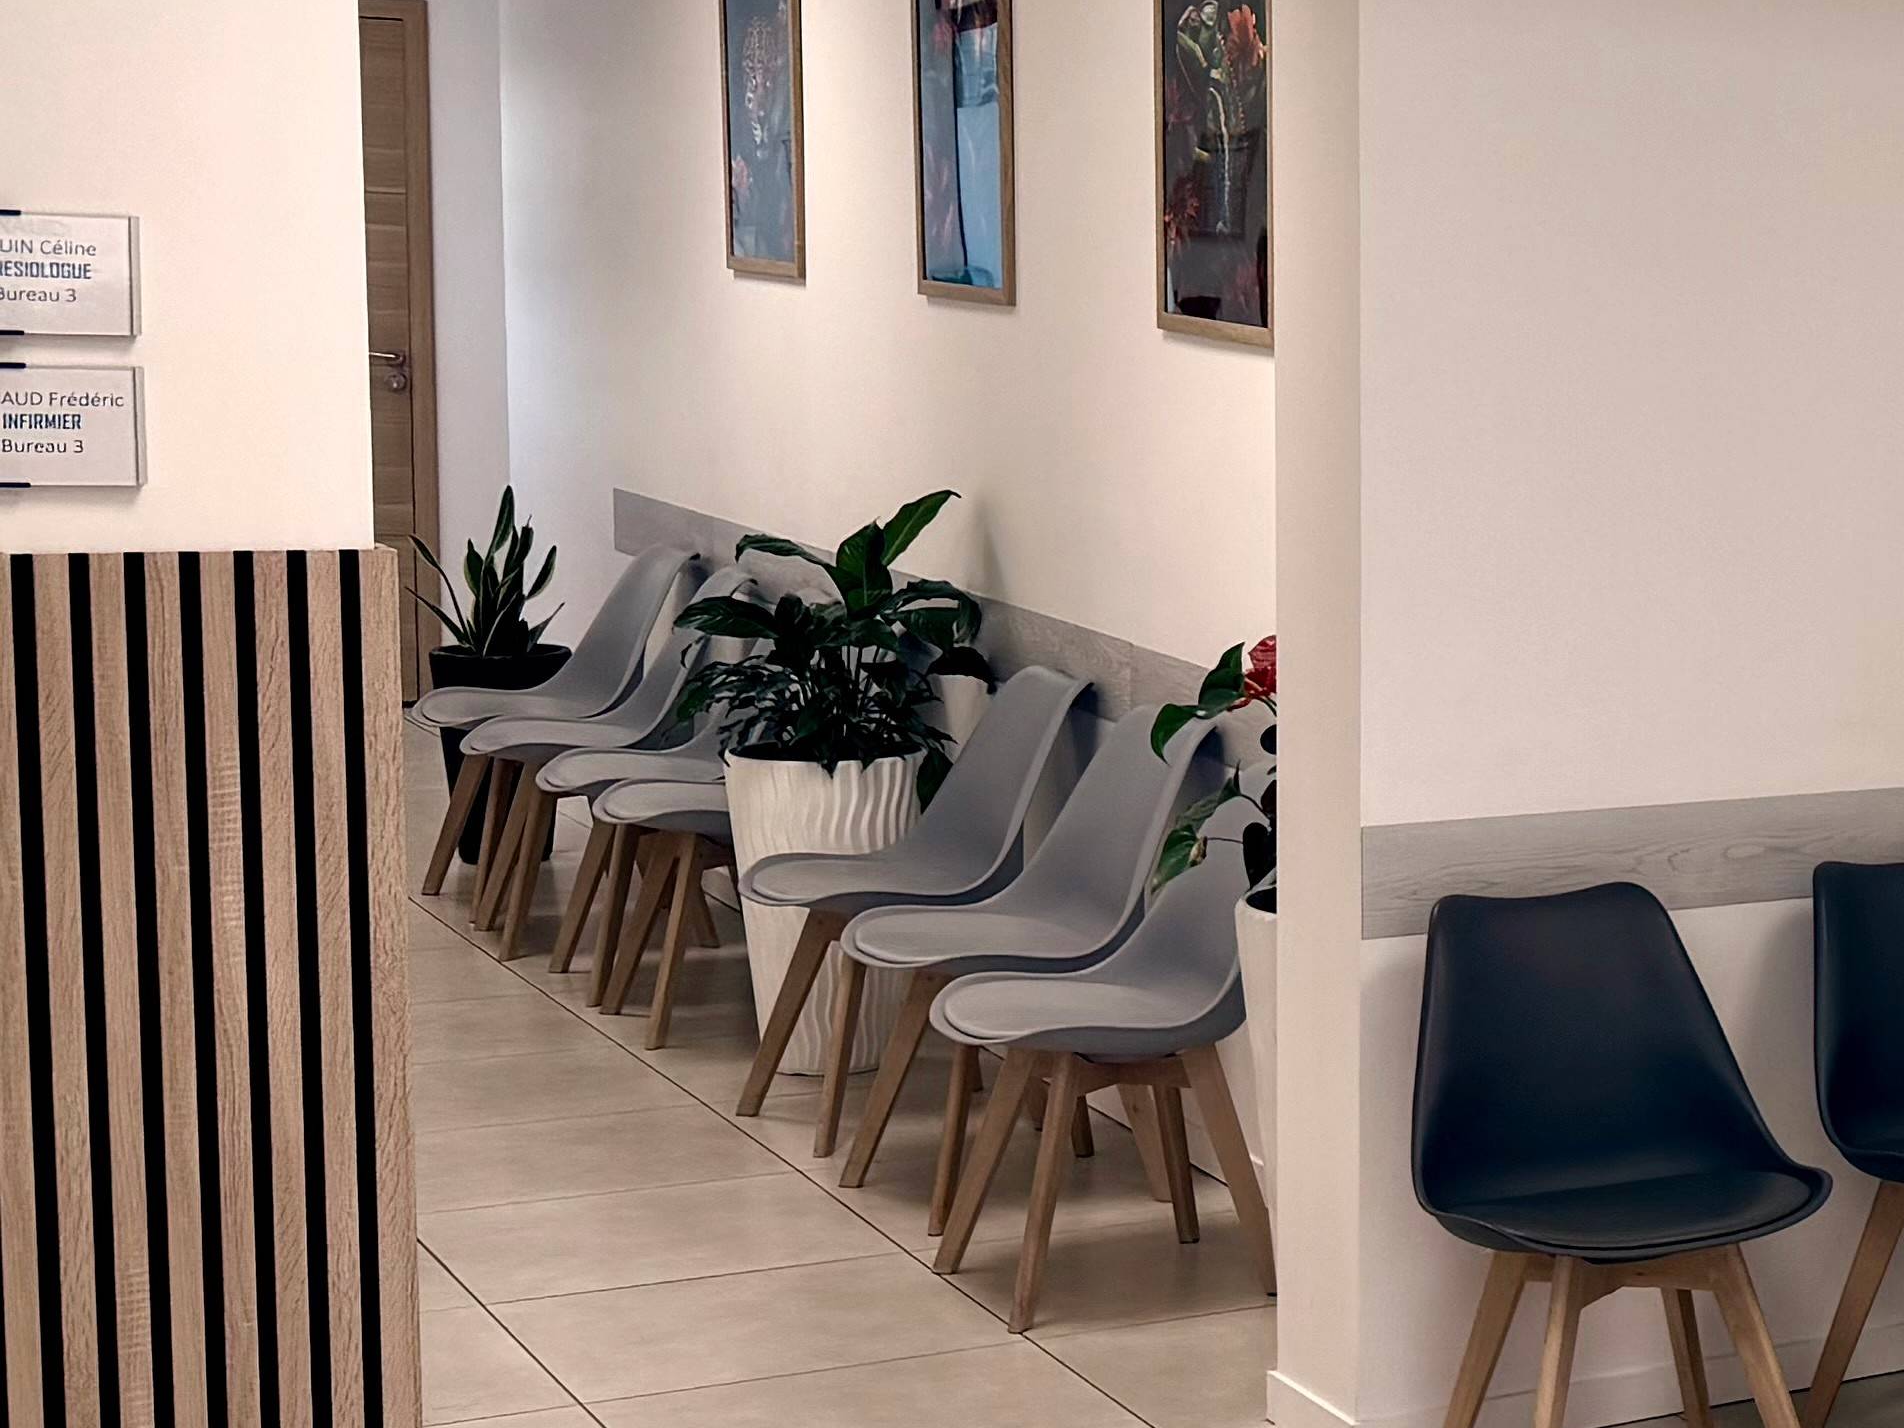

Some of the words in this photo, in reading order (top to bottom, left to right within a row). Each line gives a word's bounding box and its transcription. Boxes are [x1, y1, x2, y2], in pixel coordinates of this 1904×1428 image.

[40, 239, 97, 256] Céline
[64, 288, 77, 302] 3
[1, 391, 43, 406] AUD
[49, 391, 125, 407] Frédéric
[3, 413, 81, 429] INFIRMIER
[1, 439, 67, 453] Bureau
[73, 440, 84, 453] 3
